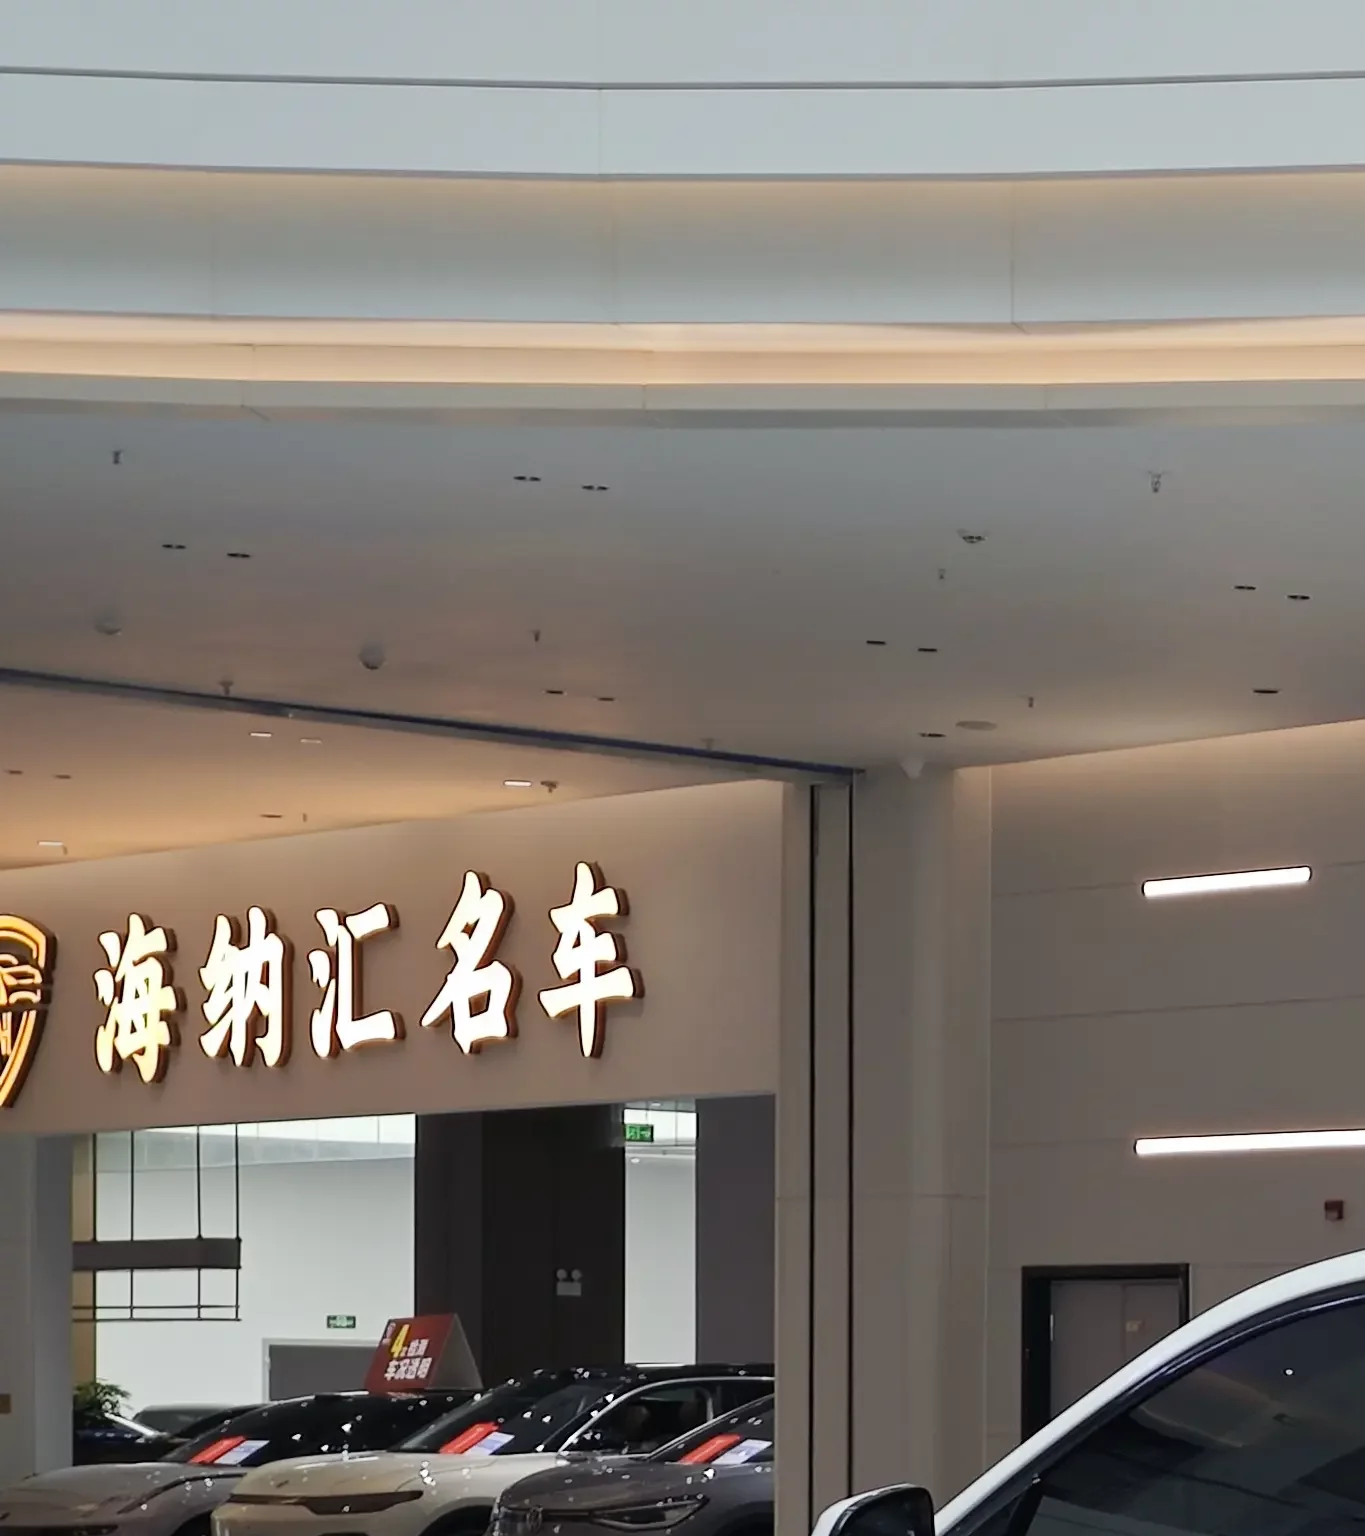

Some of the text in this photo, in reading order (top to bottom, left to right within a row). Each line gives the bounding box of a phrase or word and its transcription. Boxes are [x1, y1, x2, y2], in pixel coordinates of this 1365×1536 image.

[95, 861, 638, 1084] 海纳汇名车
